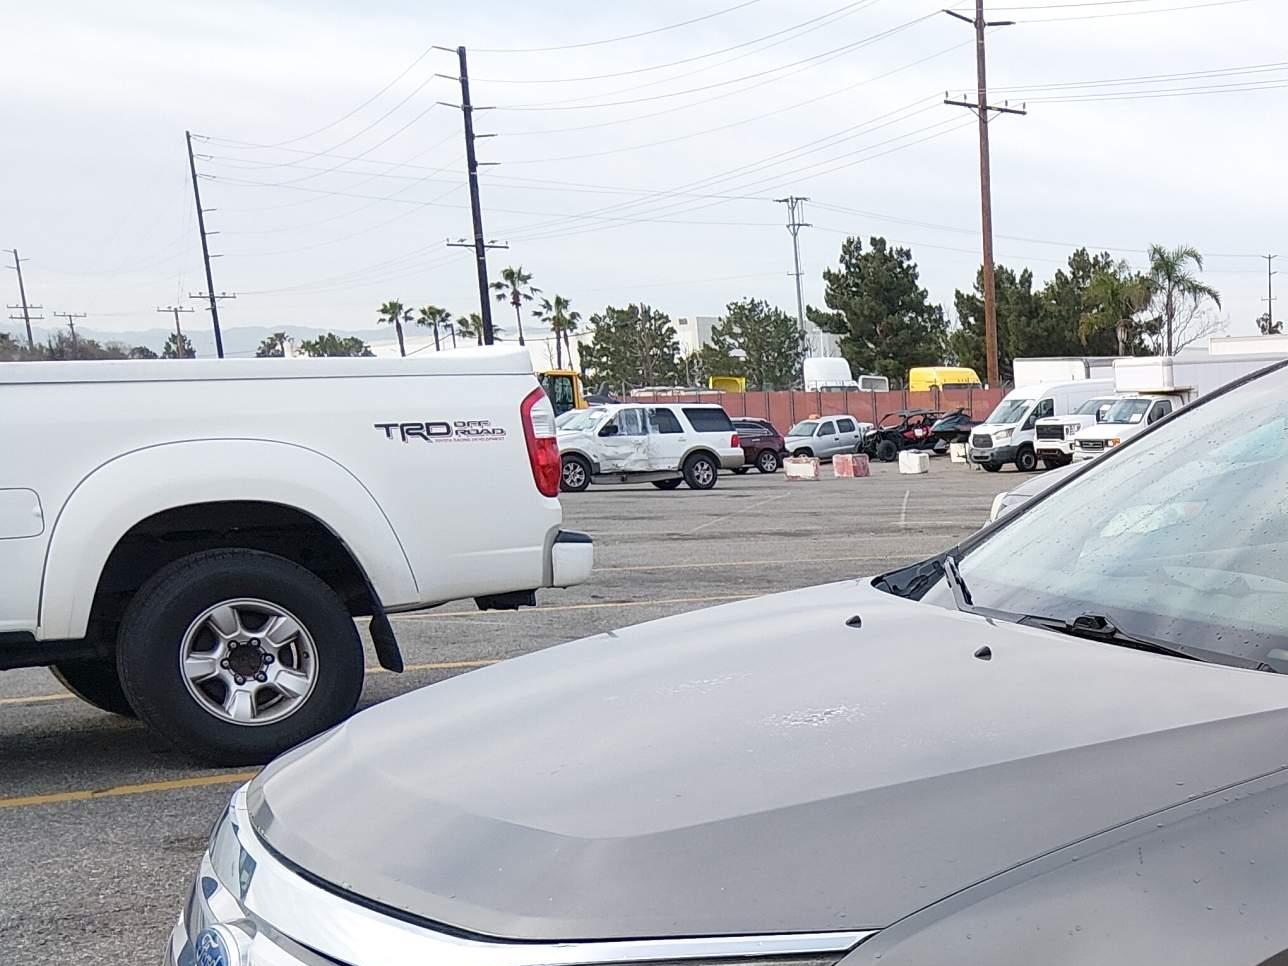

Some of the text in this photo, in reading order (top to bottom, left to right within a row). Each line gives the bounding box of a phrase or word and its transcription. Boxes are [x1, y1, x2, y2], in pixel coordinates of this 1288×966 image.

[453, 420, 491, 429] OFF
[373, 421, 453, 443] TRD
[455, 428, 506, 437] ROAD
